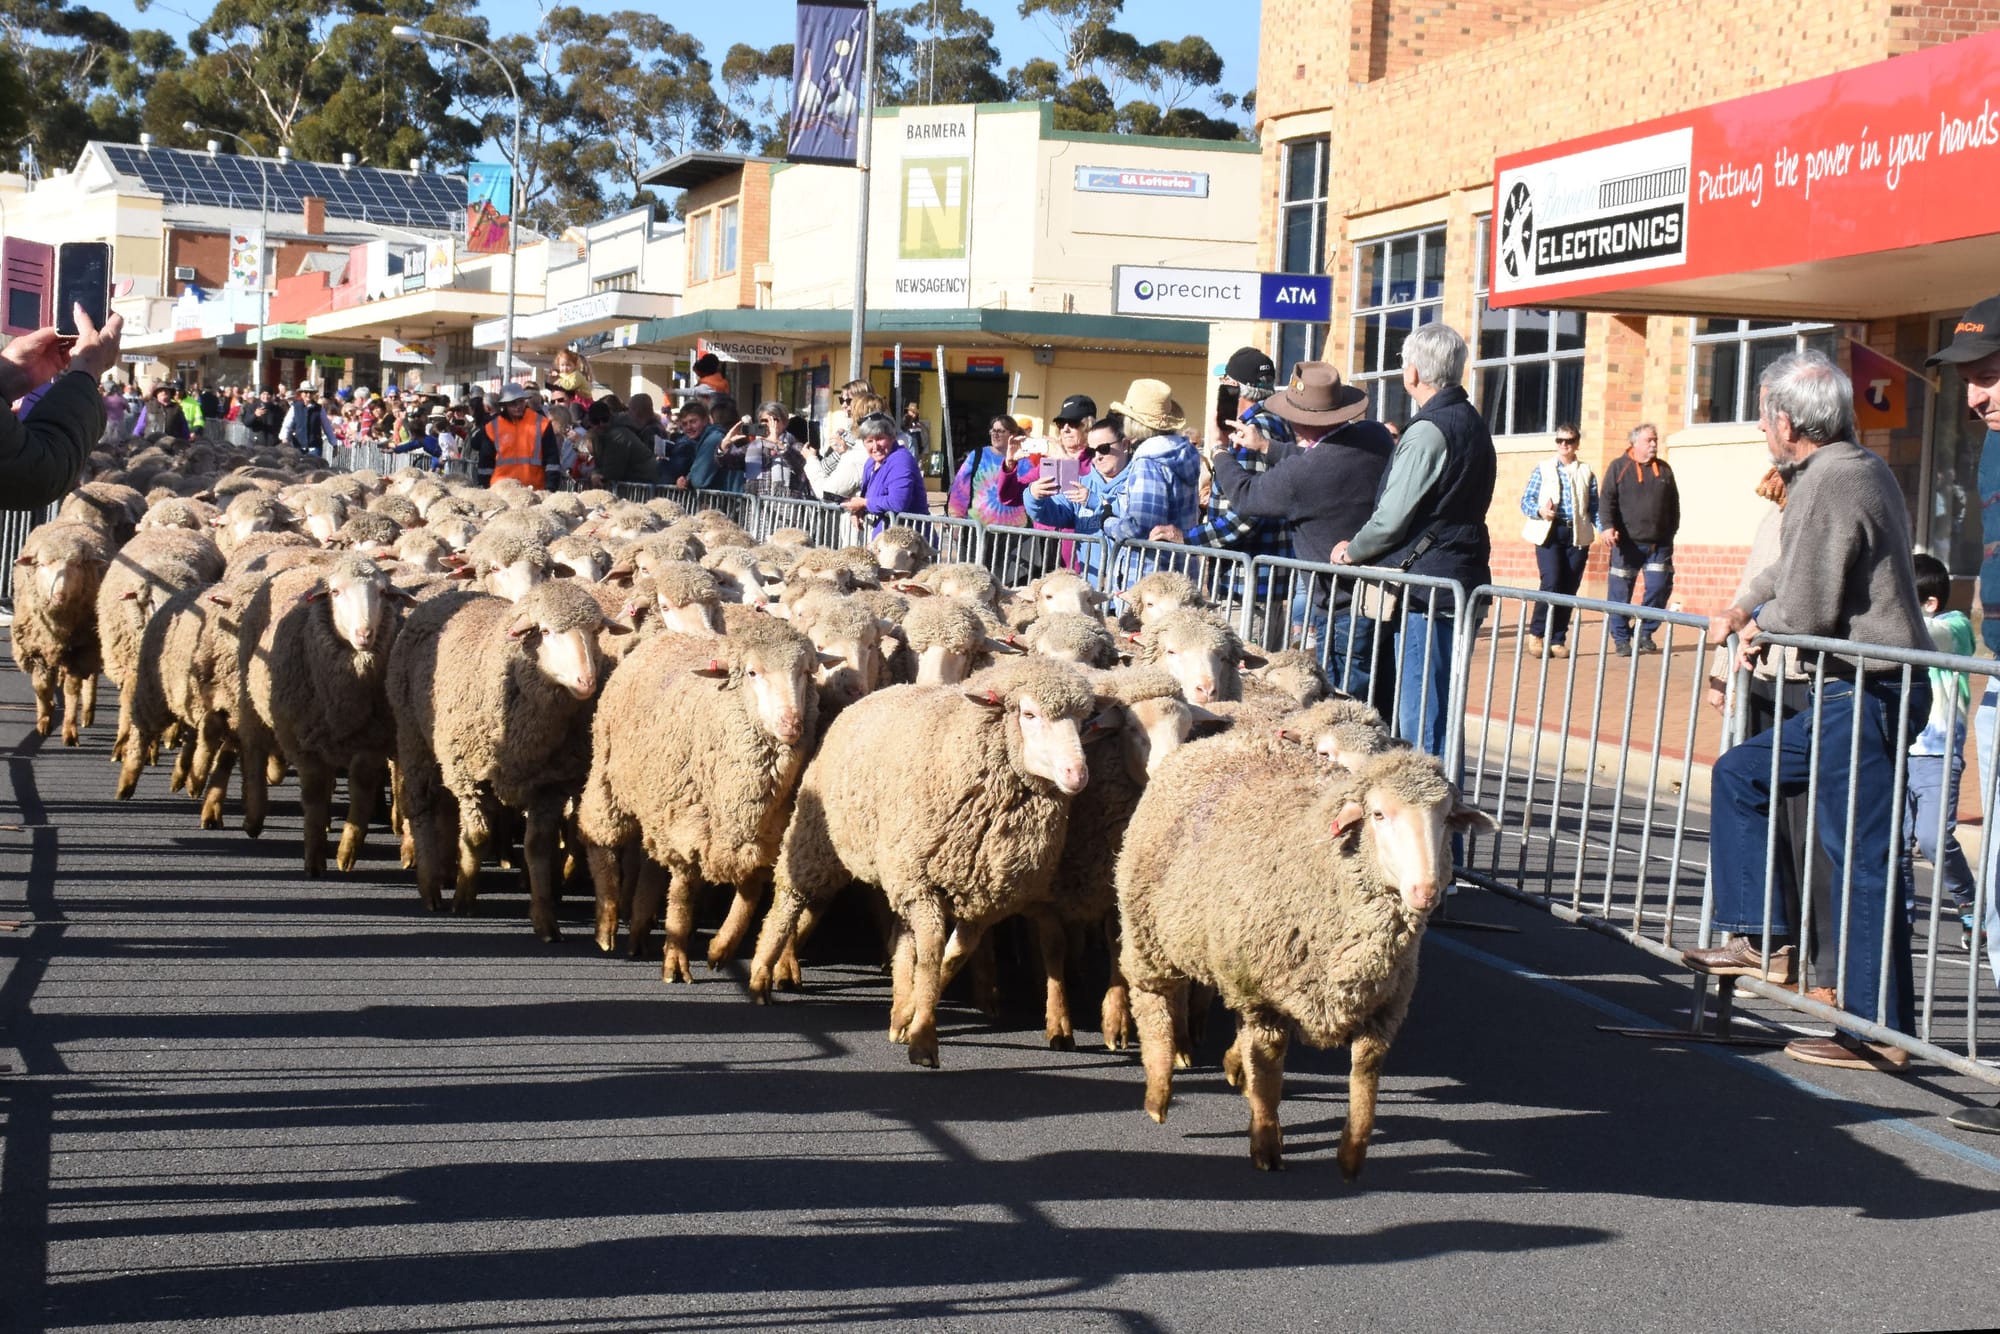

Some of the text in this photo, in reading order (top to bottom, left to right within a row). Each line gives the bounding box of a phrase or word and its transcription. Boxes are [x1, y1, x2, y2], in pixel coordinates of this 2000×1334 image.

[906, 122, 967, 140] BARMERA
[1699, 99, 2000, 208] Putting the power in your hands
[1121, 174, 1190, 189] SA Lotteries
[905, 166, 962, 250] N
[1538, 212, 1680, 266] ELECTRONICS
[895, 277, 967, 294] NEWSAGENCY
[1156, 282, 1317, 305] precinct ATM
[1954, 321, 1985, 335] ACHI
[706, 342, 787, 355] NEWSAGENCY
[1869, 378, 1892, 405] T
